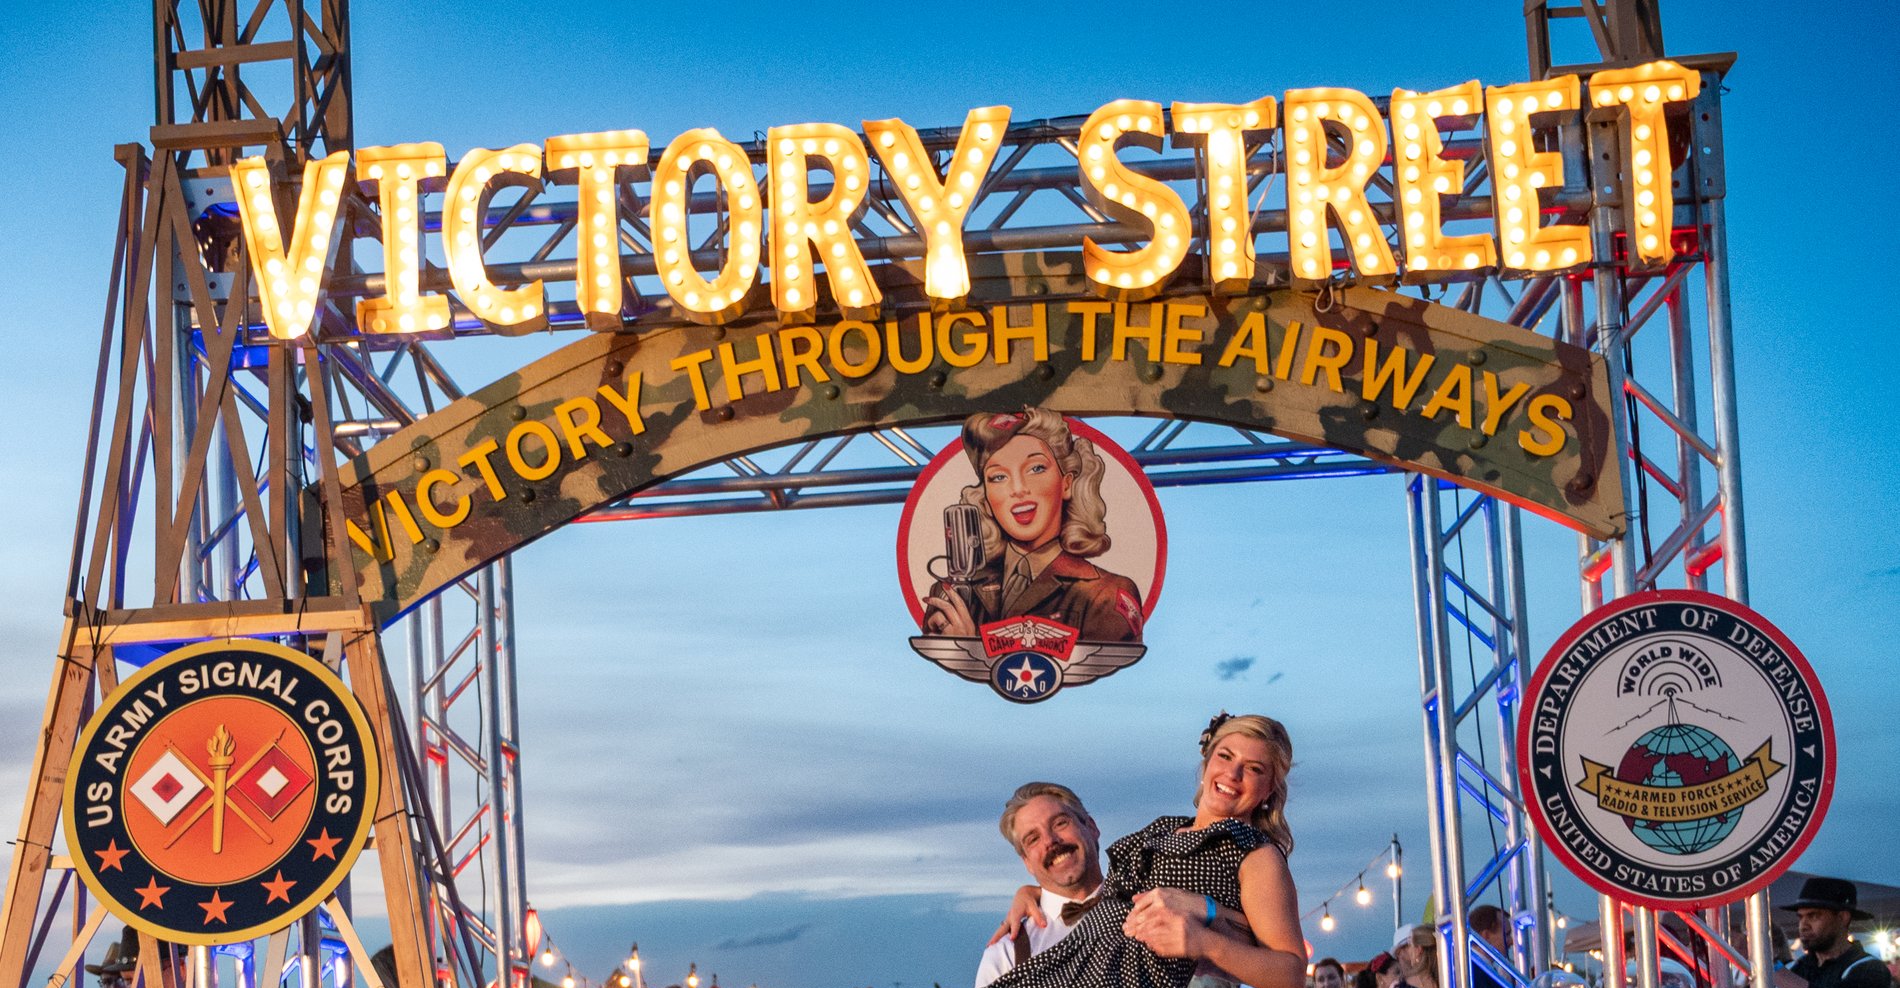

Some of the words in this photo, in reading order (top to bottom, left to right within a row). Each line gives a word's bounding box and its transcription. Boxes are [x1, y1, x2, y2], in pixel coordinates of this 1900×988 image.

[230, 105, 1012, 339] VICTORY
[1077, 60, 1701, 297] STREET
[347, 371, 649, 564] VICTORY
[671, 303, 1050, 412] THROUGH
[1068, 302, 1210, 365] THE
[1219, 310, 1575, 457] AIRWAYS
[988, 637, 1015, 652] CAMP
[1536, 608, 1658, 754] DEPARTMENT
[1680, 606, 1718, 631] OF
[1727, 622, 1814, 734] DEFENSE
[1622, 646, 1673, 695] WORLD
[1678, 646, 1717, 689] WIDE
[178, 661, 299, 706] SIGNAL
[95, 681, 168, 774] ARMY
[304, 699, 354, 815] CORPS
[87, 781, 113, 828] US
[1601, 794, 1638, 814] RADIO
[1640, 804, 1649, 816] &
[1653, 801, 1718, 818] TELEVISION
[1721, 777, 1764, 808] SERVICE
[1631, 787, 1676, 804] ARMED
[1681, 782, 1725, 802] FORCES
[1546, 795, 1613, 872] UNITED
[1614, 863, 1706, 893] STATES
[1712, 863, 1744, 888] OF
[1750, 776, 1816, 872] AMERICA
